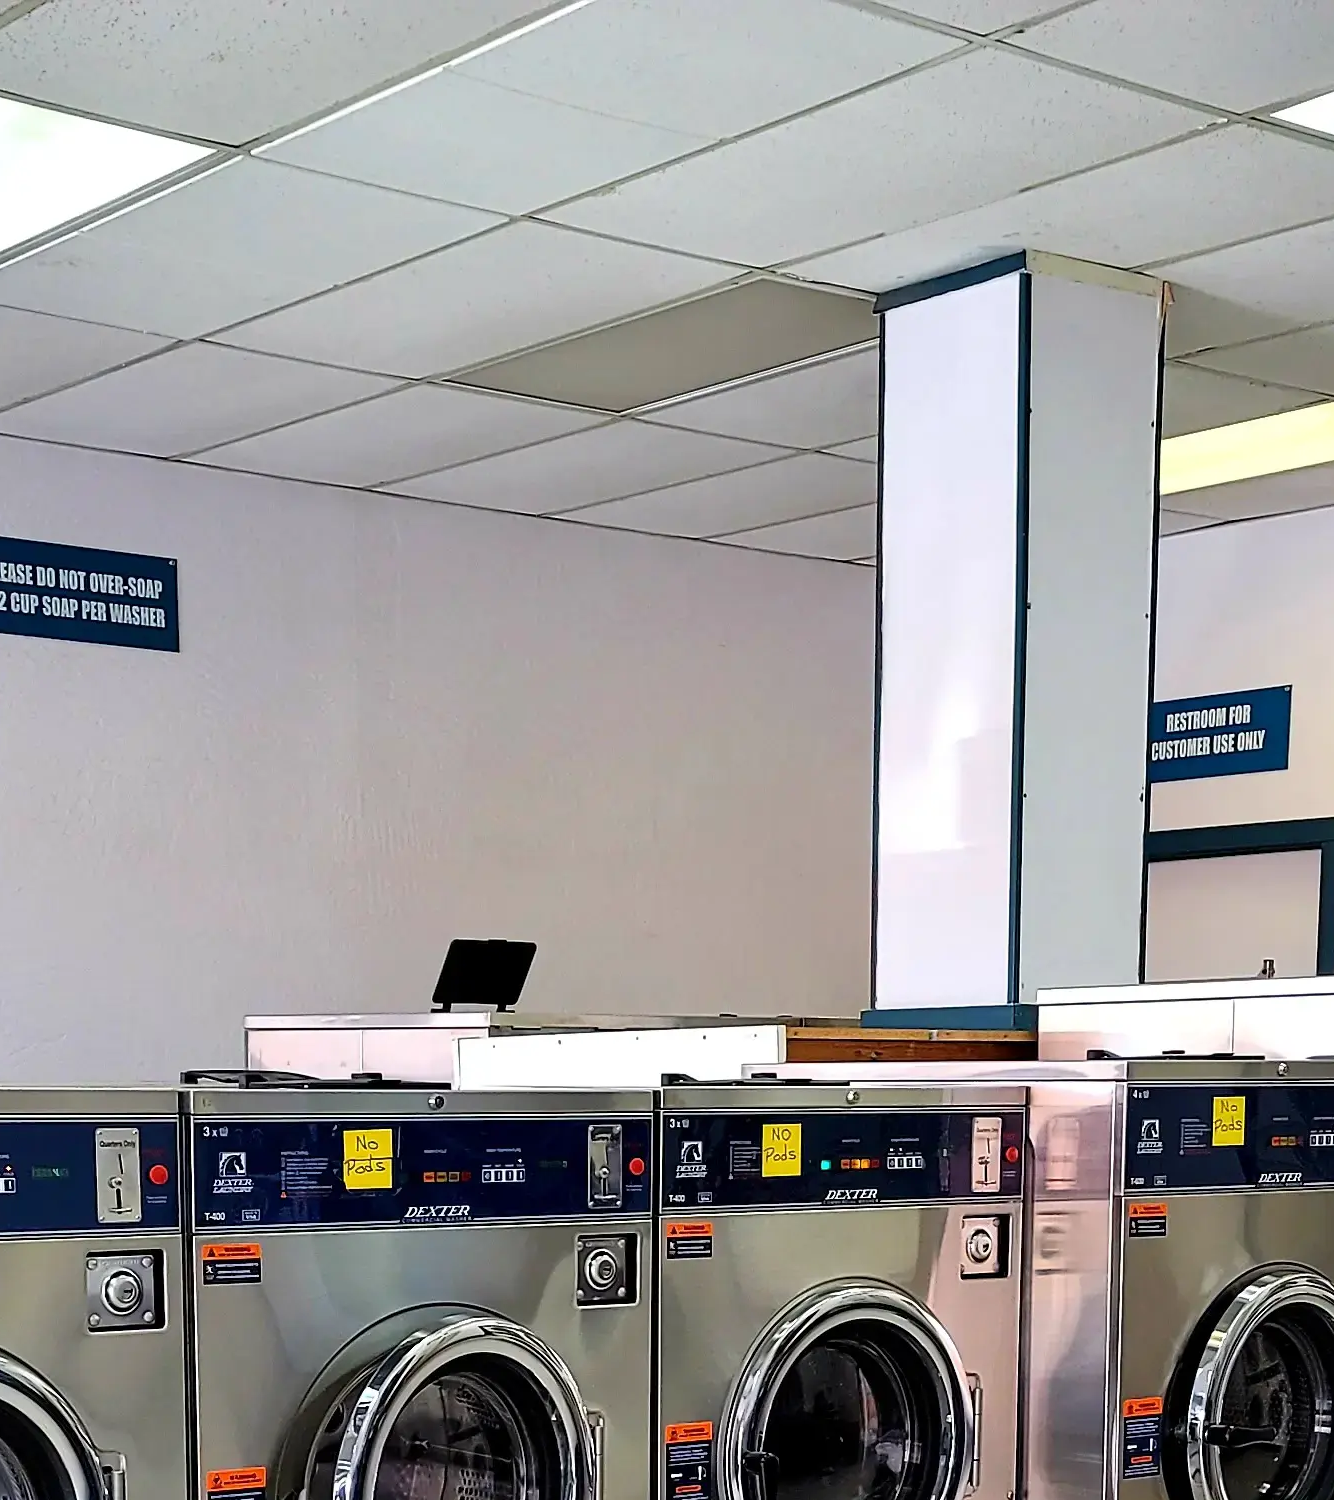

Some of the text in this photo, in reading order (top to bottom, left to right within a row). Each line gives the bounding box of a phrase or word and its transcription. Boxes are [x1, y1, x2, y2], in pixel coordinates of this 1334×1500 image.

[36, 566, 55, 588] DO
[59, 569, 86, 591] NOT
[90, 573, 163, 600] OVER-SOAP
[11, 593, 38, 614] CUP
[43, 597, 78, 618] SOAP
[82, 600, 107, 621] PER
[109, 603, 165, 628] WASHER
[1166, 705, 1251, 732] RESTROOM FOR
[1152, 730, 1265, 761] CUSTOMER USE ONLY
[1221, 1100, 1237, 1113] No
[669, 1119, 675, 1128] 3
[1215, 1116, 1242, 1132] Pods
[203, 1127, 210, 1137] 3
[772, 1128, 791, 1141] NO
[99, 1139, 136, 1148] Quarters Only
[356, 1135, 379, 1152] No
[764, 1144, 796, 1163] Pods
[345, 1154, 385, 1176] Pods
[1258, 1172, 1302, 1183] DEXTER
[825, 1188, 877, 1199] DEXTER
[204, 1212, 225, 1221] T-400
[404, 1205, 470, 1218] DEXTER
